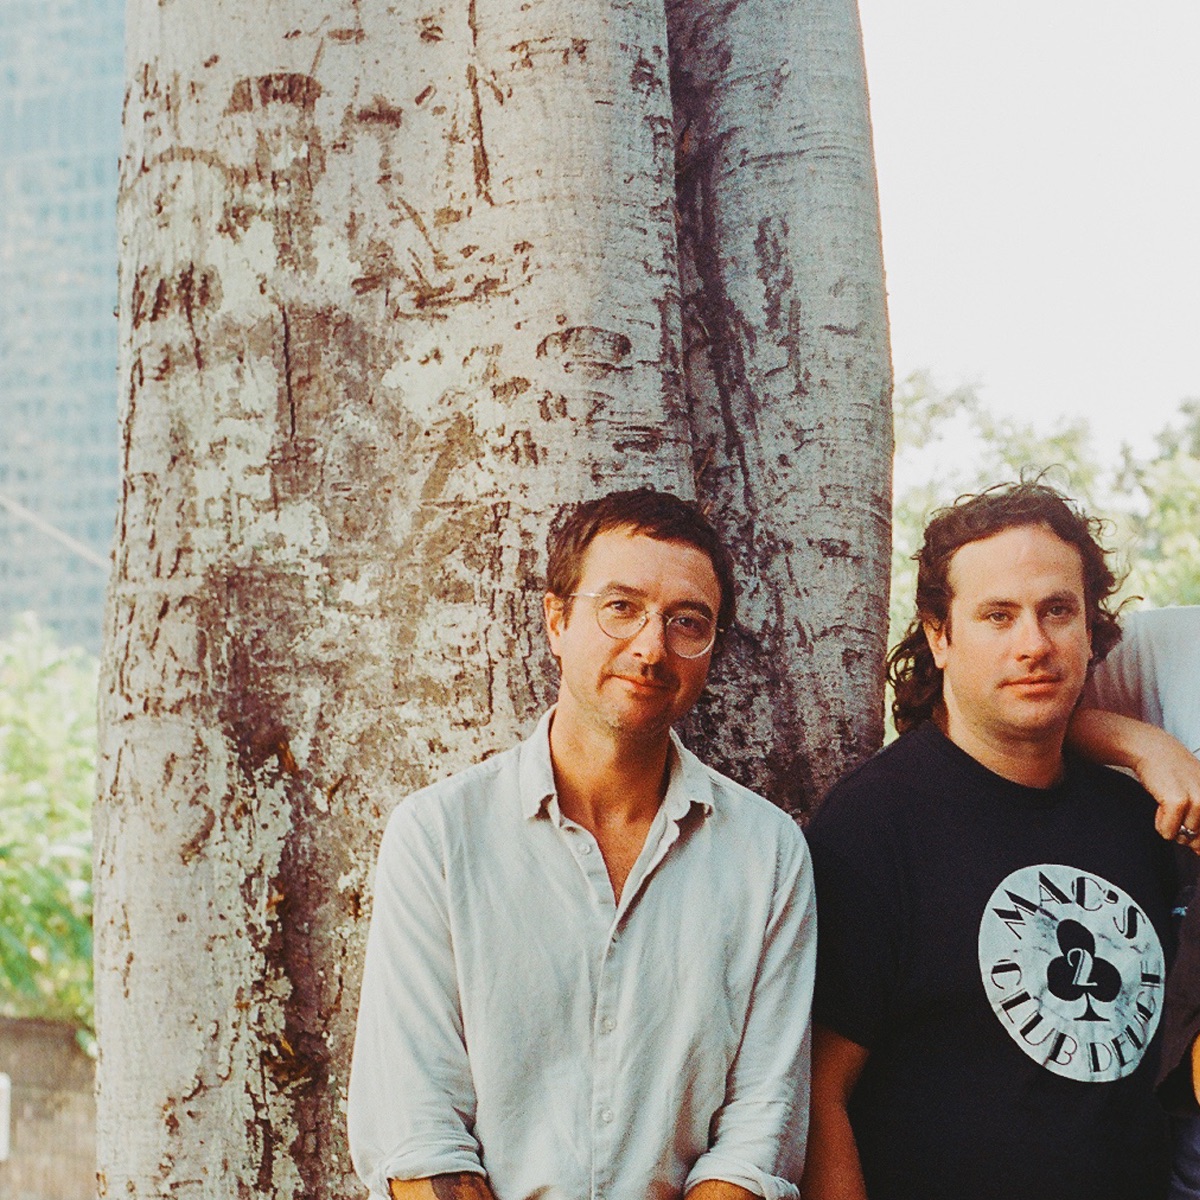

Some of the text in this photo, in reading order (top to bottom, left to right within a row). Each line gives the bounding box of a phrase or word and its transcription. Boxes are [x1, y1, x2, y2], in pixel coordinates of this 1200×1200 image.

[992, 871, 1147, 940] MAC'S
[1067, 947, 1098, 987] 2
[990, 958, 1078, 1066] CLUB
